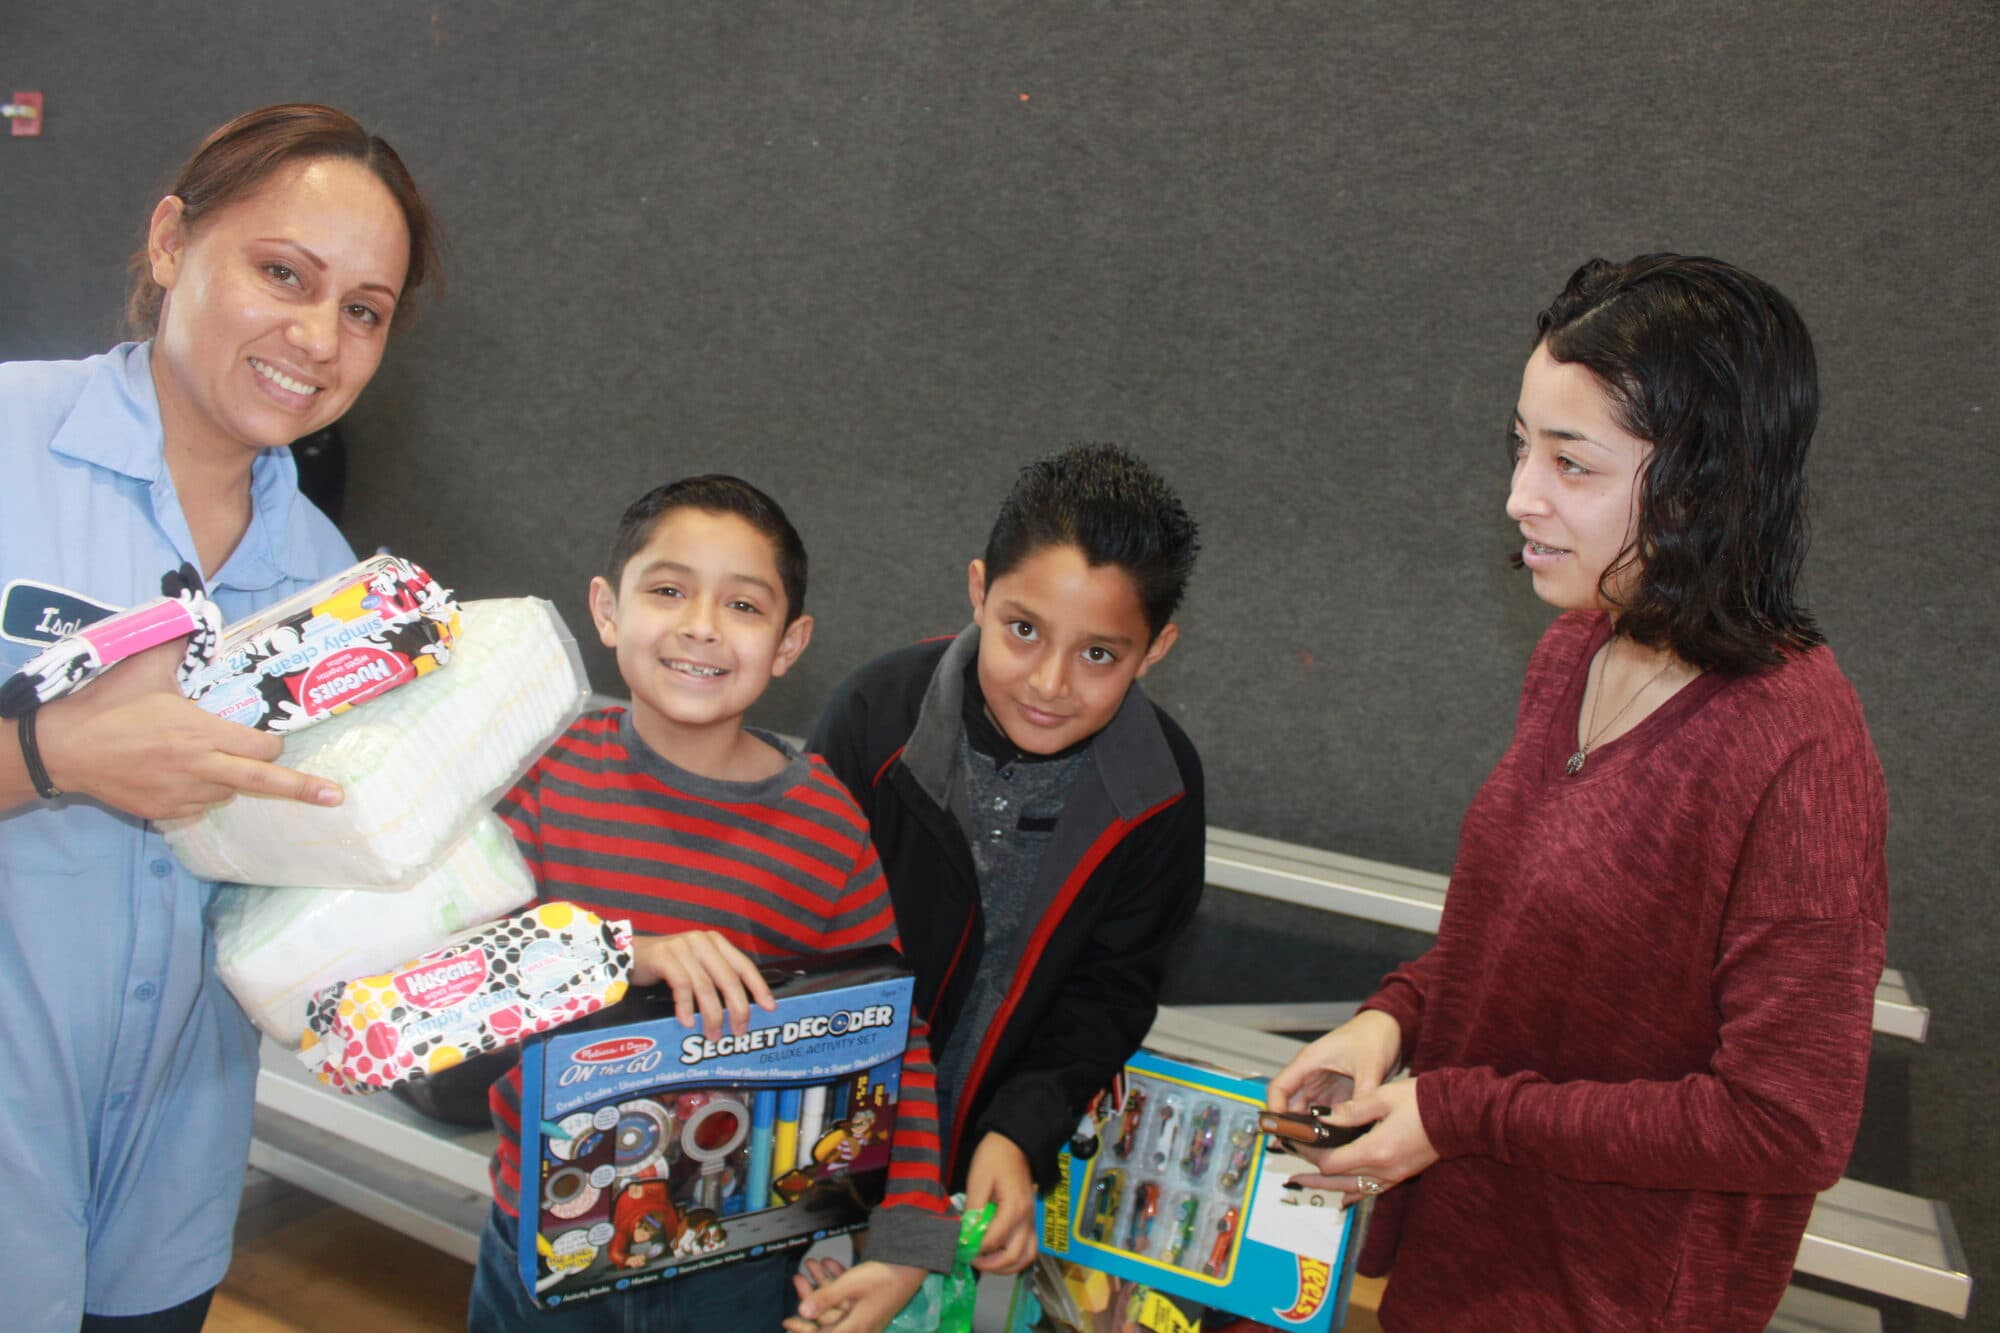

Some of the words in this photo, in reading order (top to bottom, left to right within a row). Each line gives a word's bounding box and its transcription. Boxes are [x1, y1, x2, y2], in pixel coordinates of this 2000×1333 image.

[322, 618, 384, 653] simply
[228, 652, 252, 671] 72
[266, 646, 319, 678] clean
[308, 656, 393, 705] HUGGIES
[468, 989, 514, 1013] clean
[679, 1027, 780, 1065] SECRET
[781, 1005, 894, 1044] DECODER
[759, 1044, 802, 1065] DELUXE
[806, 1036, 855, 1056] ACTIVITY
[855, 1032, 879, 1047] SET
[559, 1063, 597, 1088] ON
[625, 1050, 663, 1074] GO
